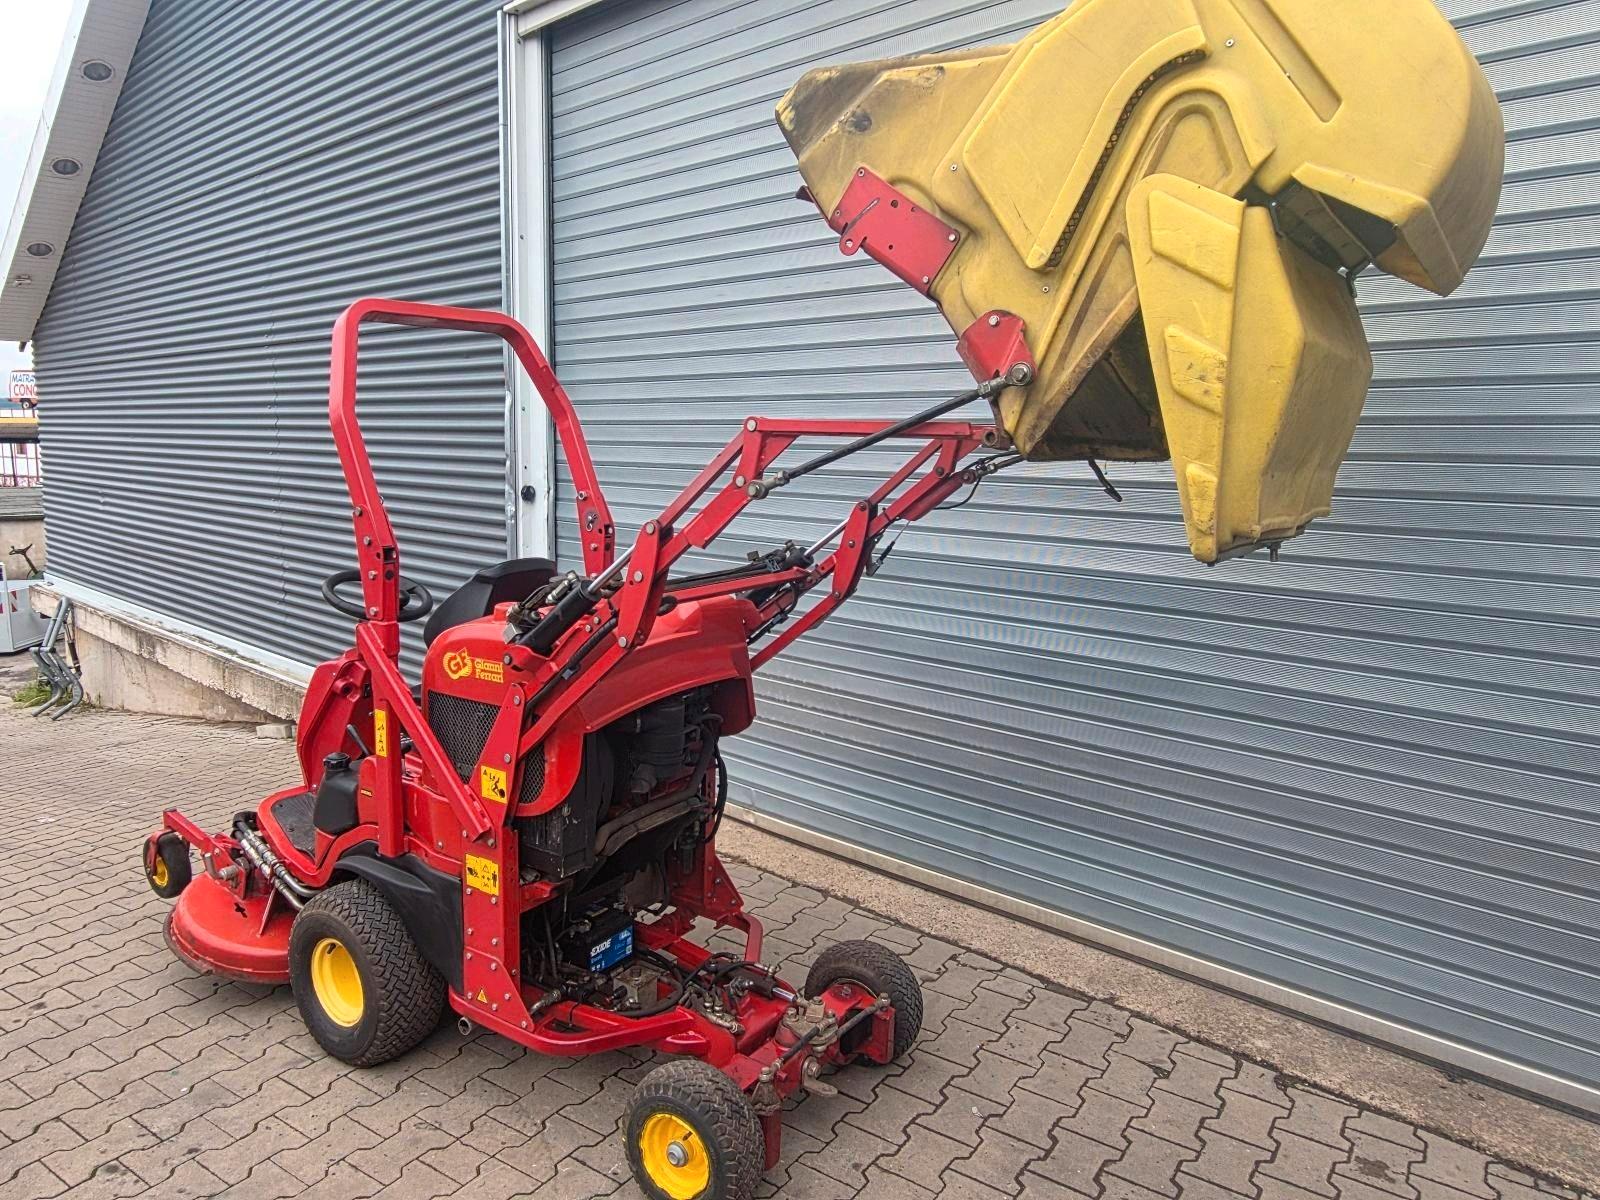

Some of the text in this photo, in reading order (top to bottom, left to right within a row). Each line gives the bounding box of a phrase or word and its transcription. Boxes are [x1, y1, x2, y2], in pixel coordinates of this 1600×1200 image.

[475, 658, 503, 673] Gianni
[475, 668, 504, 683] Ferrari
[590, 938, 612, 957] EXIDE
